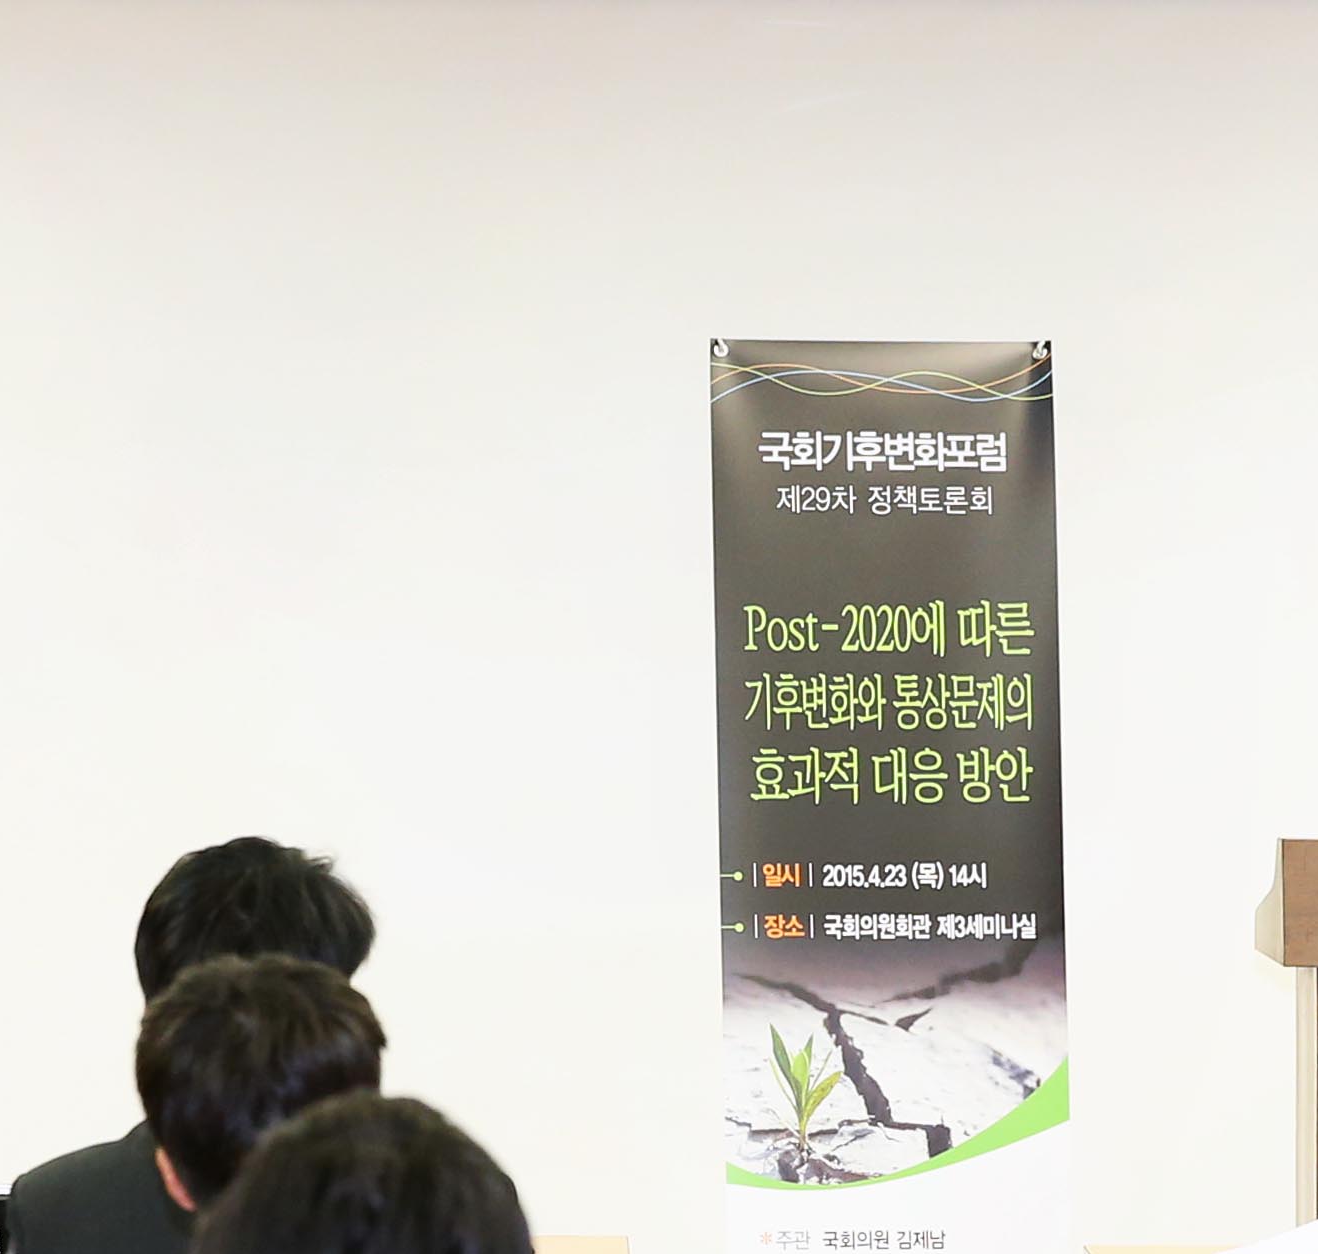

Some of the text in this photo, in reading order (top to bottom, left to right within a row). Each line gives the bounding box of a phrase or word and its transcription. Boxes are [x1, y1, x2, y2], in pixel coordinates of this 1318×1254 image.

[758, 430, 1007, 473] 국회기후변화포럼
[776, 484, 994, 516] 제29차 정책토론회
[743, 600, 1035, 657] Post-2020에 따른
[744, 673, 1032, 731] 기후변화와 통상문제의
[750, 747, 1034, 805] 효과적 대응 방안
[762, 860, 988, 890] 일시 2015.4.23 (목) 14시
[763, 912, 1037, 940] 장소 국회의원회관 제3세미나실
[776, 1230, 946, 1250] 주관 국회의원 김제남
